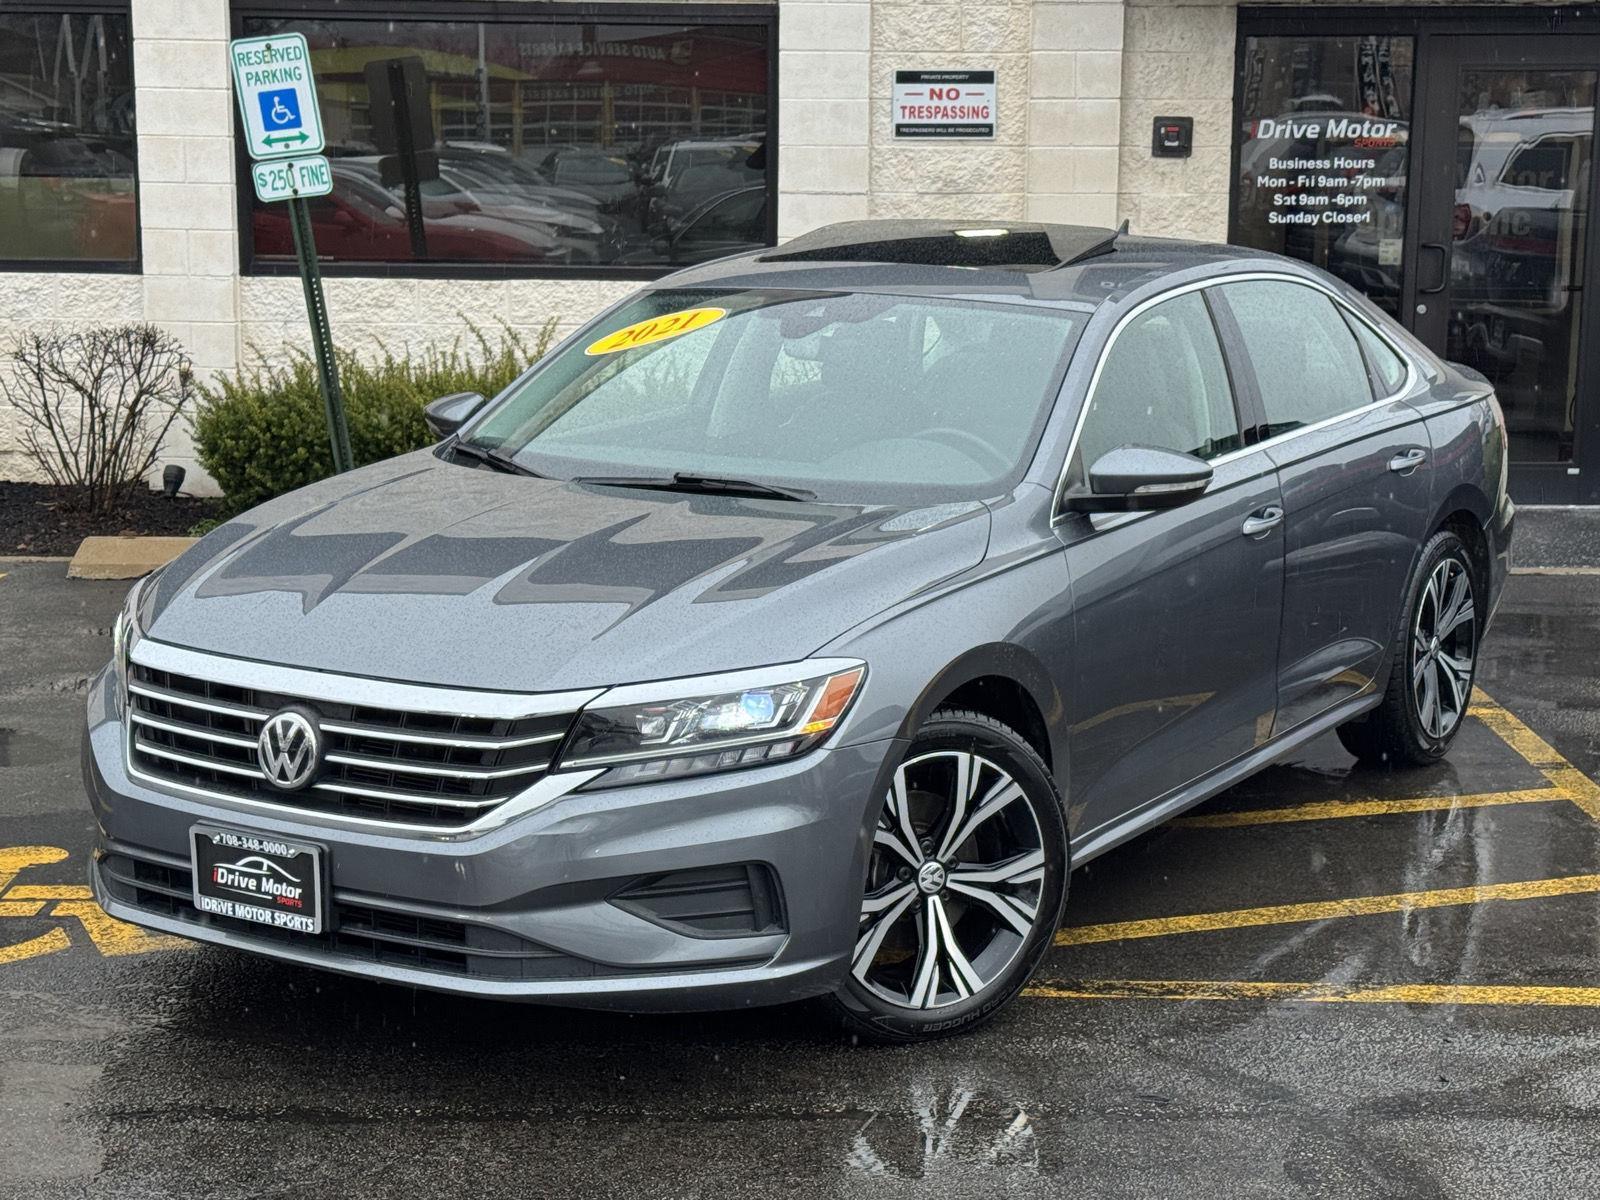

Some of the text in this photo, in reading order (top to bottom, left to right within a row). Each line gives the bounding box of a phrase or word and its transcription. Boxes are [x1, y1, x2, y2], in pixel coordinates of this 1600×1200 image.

[237, 46, 302, 68] RESERVED
[245, 66, 302, 87] PARKING
[929, 88, 960, 101] NO
[900, 105, 990, 119] TRESPASSING
[1325, 118, 1397, 139] Motor
[1352, 138, 1396, 148] SPORTS
[1269, 157, 1375, 169] Business Hours
[300, 164, 328, 187] FINE
[1257, 176, 1287, 188] Mon
[1317, 176, 1348, 188] 9am
[1273, 194, 1296, 206] Sat
[1298, 194, 1328, 206] 9am
[1268, 211, 1370, 225] Sunday Closed
[607, 312, 700, 350] 2021
[220, 833, 288, 856] 708-348-0000
[213, 867, 303, 899] iDrive Motor
[276, 896, 303, 908] SPORTS
[235, 905, 272, 924] MOTOR
[273, 912, 314, 931] SPORTS
